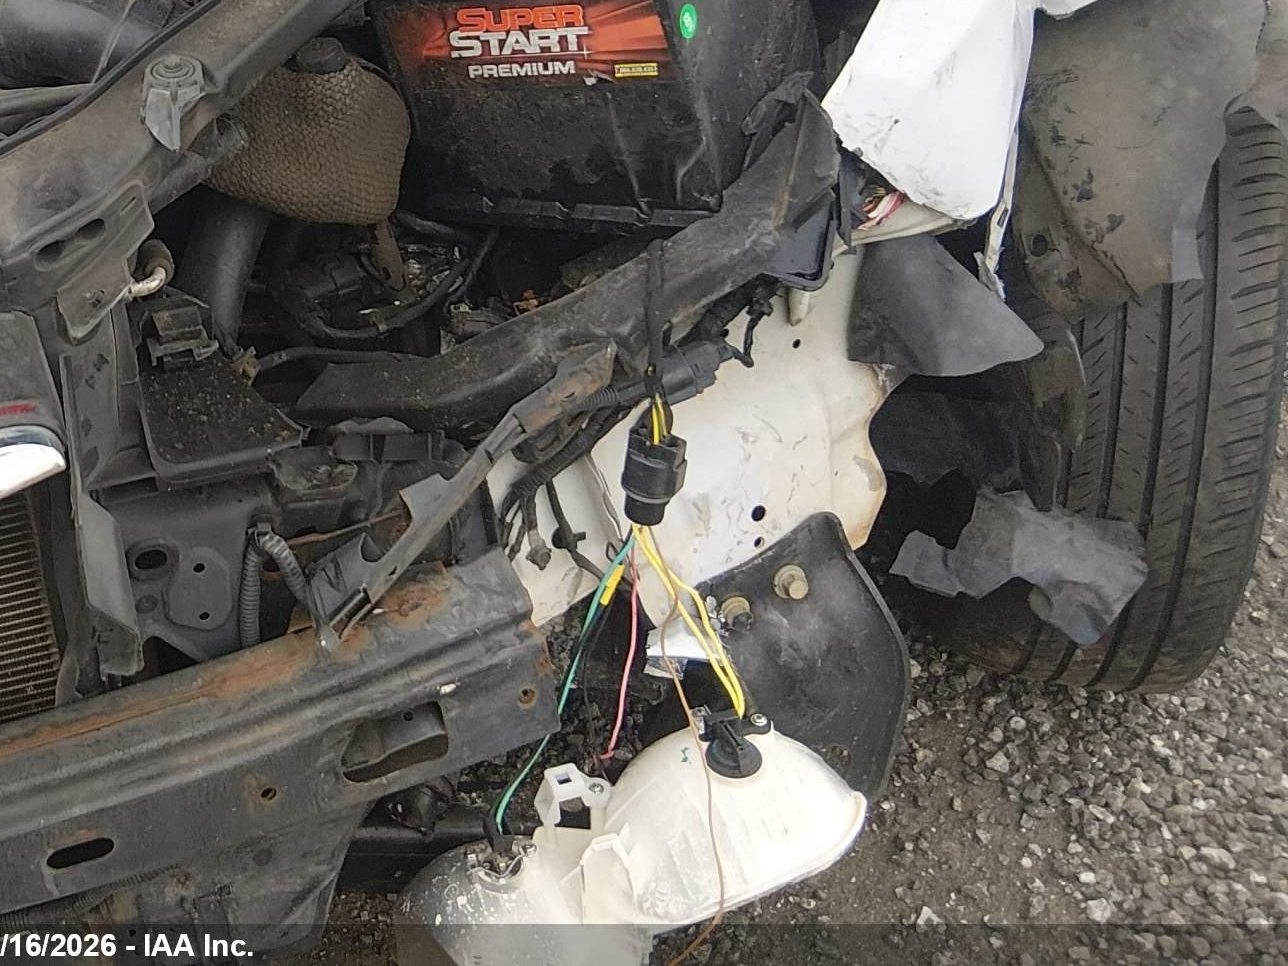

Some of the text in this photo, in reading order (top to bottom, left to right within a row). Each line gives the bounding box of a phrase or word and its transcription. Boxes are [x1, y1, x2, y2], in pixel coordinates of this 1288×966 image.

[456, 4, 585, 32] SUPER
[449, 26, 589, 58] START
[468, 60, 576, 79] PREMIUM
